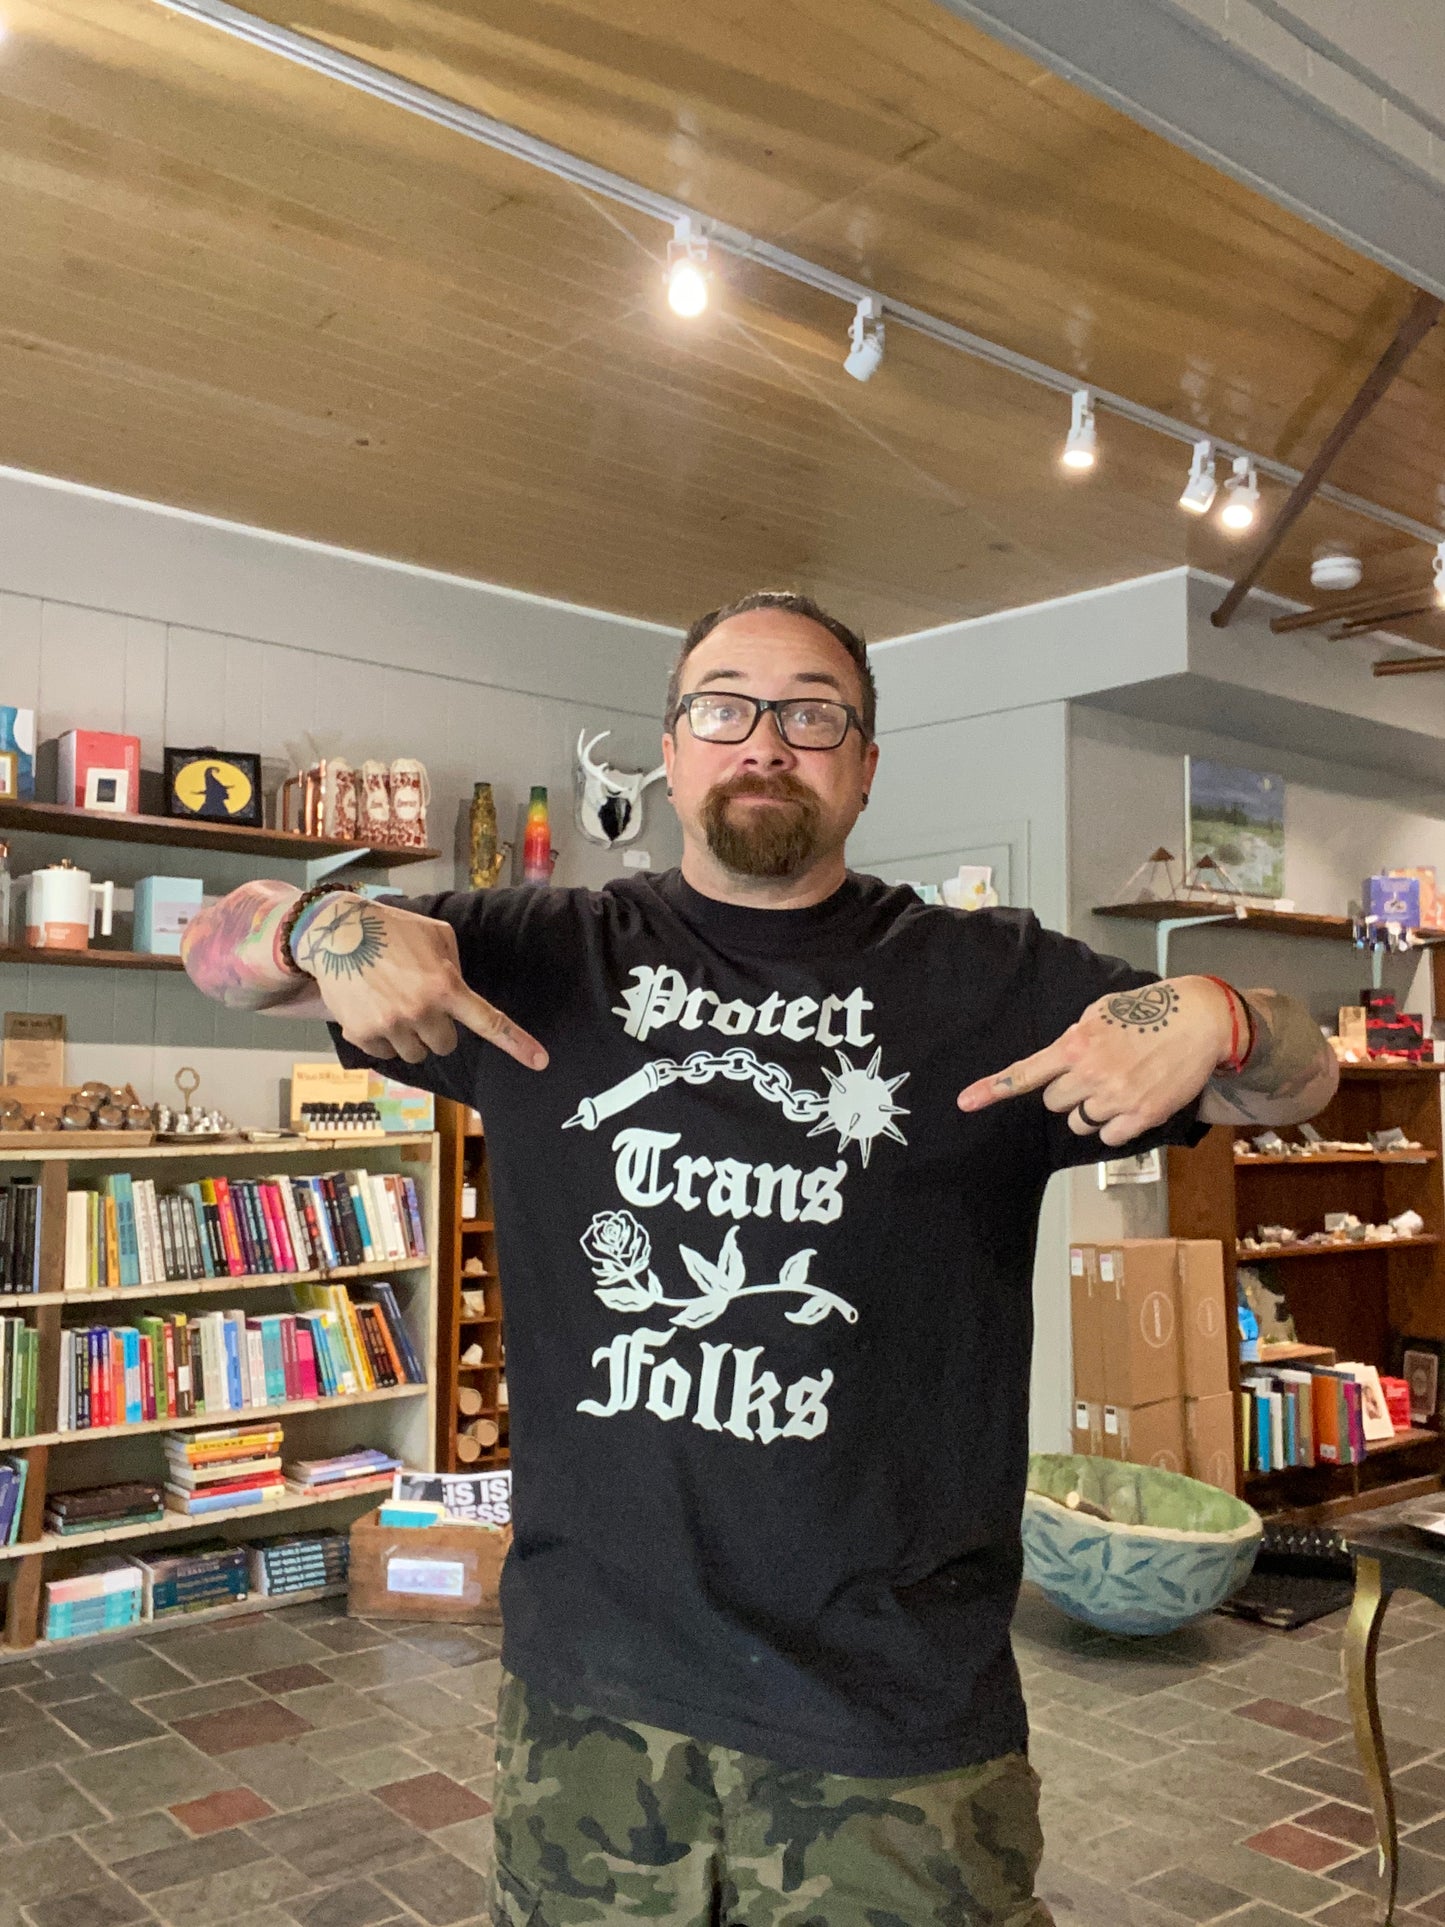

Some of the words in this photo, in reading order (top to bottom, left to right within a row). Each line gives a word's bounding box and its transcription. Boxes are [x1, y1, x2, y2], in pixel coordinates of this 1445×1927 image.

[611, 964, 876, 1048] Protect
[611, 1127, 848, 1224] Trans
[576, 1327, 834, 1445] Folks
[479, 1478, 509, 1503] IS
